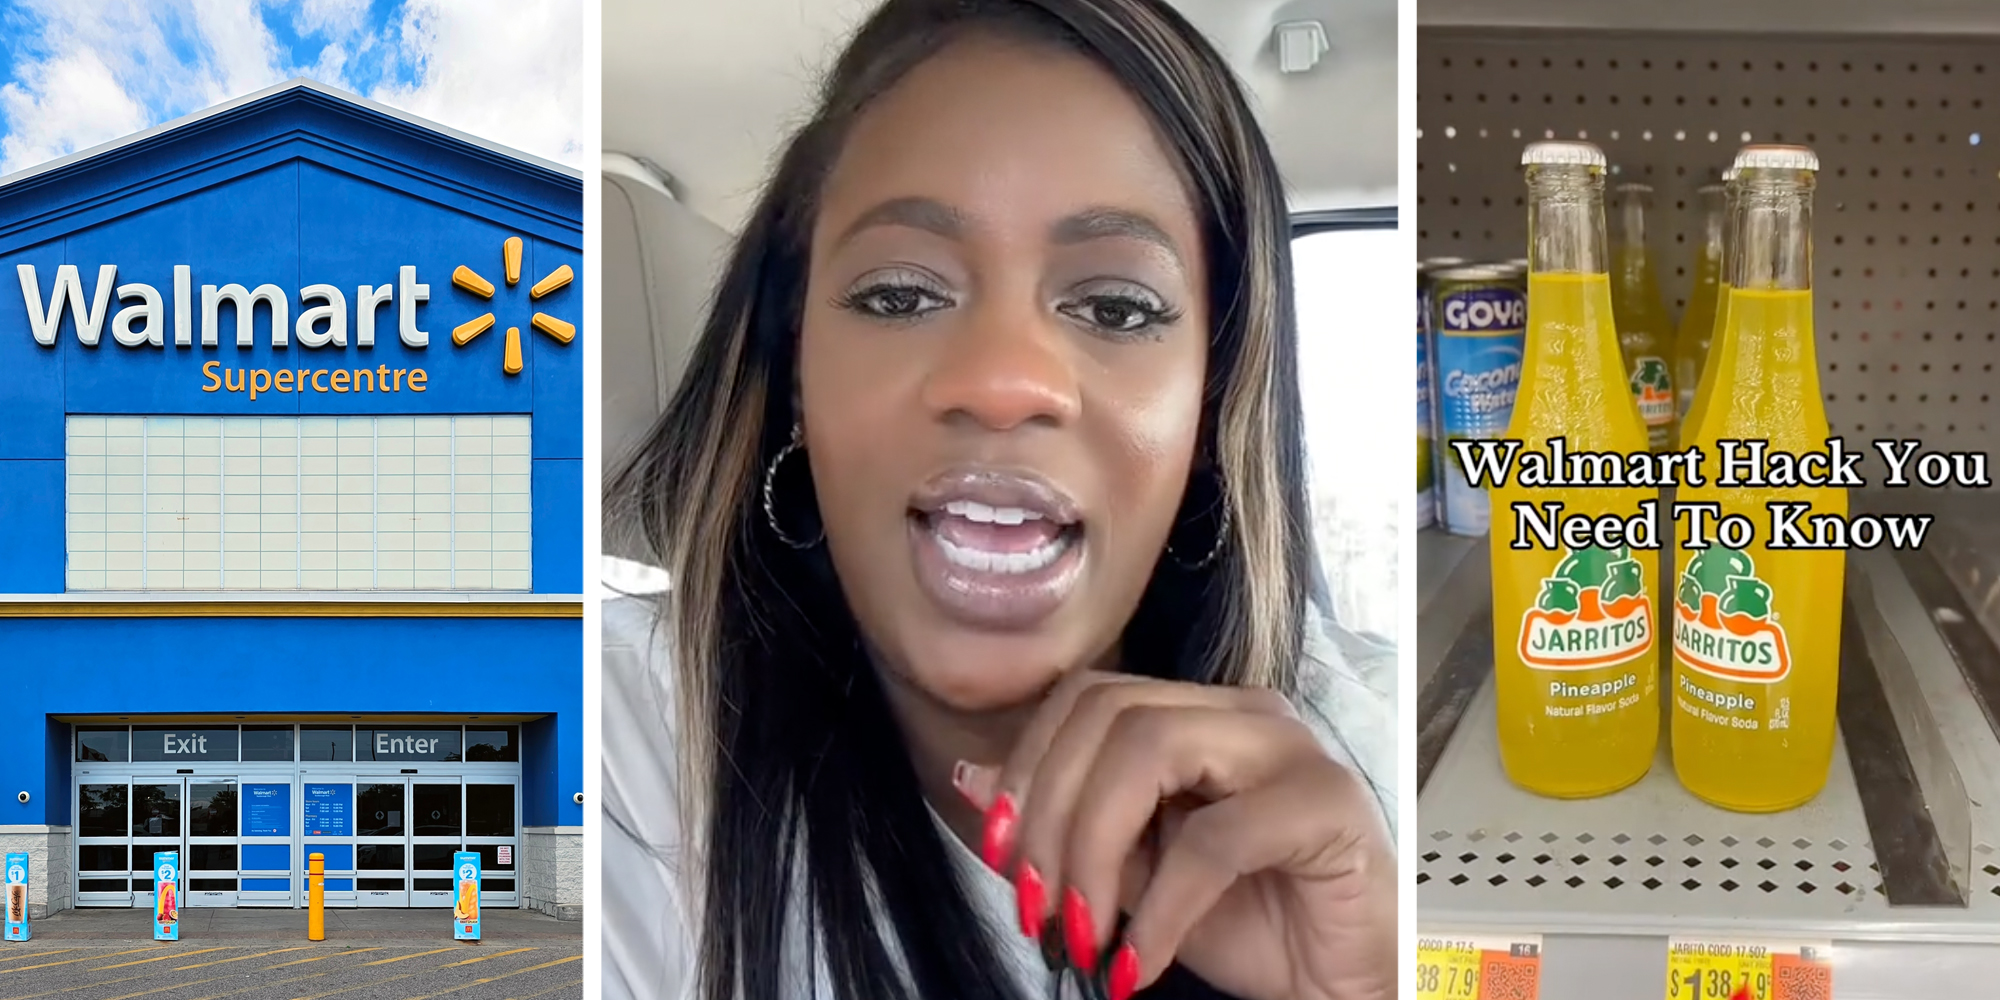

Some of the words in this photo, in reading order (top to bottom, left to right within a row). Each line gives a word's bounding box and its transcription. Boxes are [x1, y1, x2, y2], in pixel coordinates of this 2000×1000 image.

[17, 264, 430, 347] Walmart
[202, 360, 428, 400] Supercentre
[1532, 616, 1646, 652] JARRITOS
[1674, 617, 1772, 665] JARRITOS
[1550, 673, 1636, 697] Pineapple
[1680, 674, 1755, 710] Pineapple
[1545, 705, 1583, 717] Natural
[1586, 701, 1617, 715] Flavor
[1618, 693, 1640, 709] Soda
[1701, 708, 1729, 726] Flavor
[1731, 716, 1758, 729] Soda
[163, 733, 207, 754] Exit
[376, 733, 439, 754] Enter
[1419, 939, 1442, 951] COCO
[1446, 941, 1453, 952] P
[1518, 945, 1531, 956] 16
[1671, 943, 1705, 956] JARITO
[1708, 944, 1732, 957] COCO
